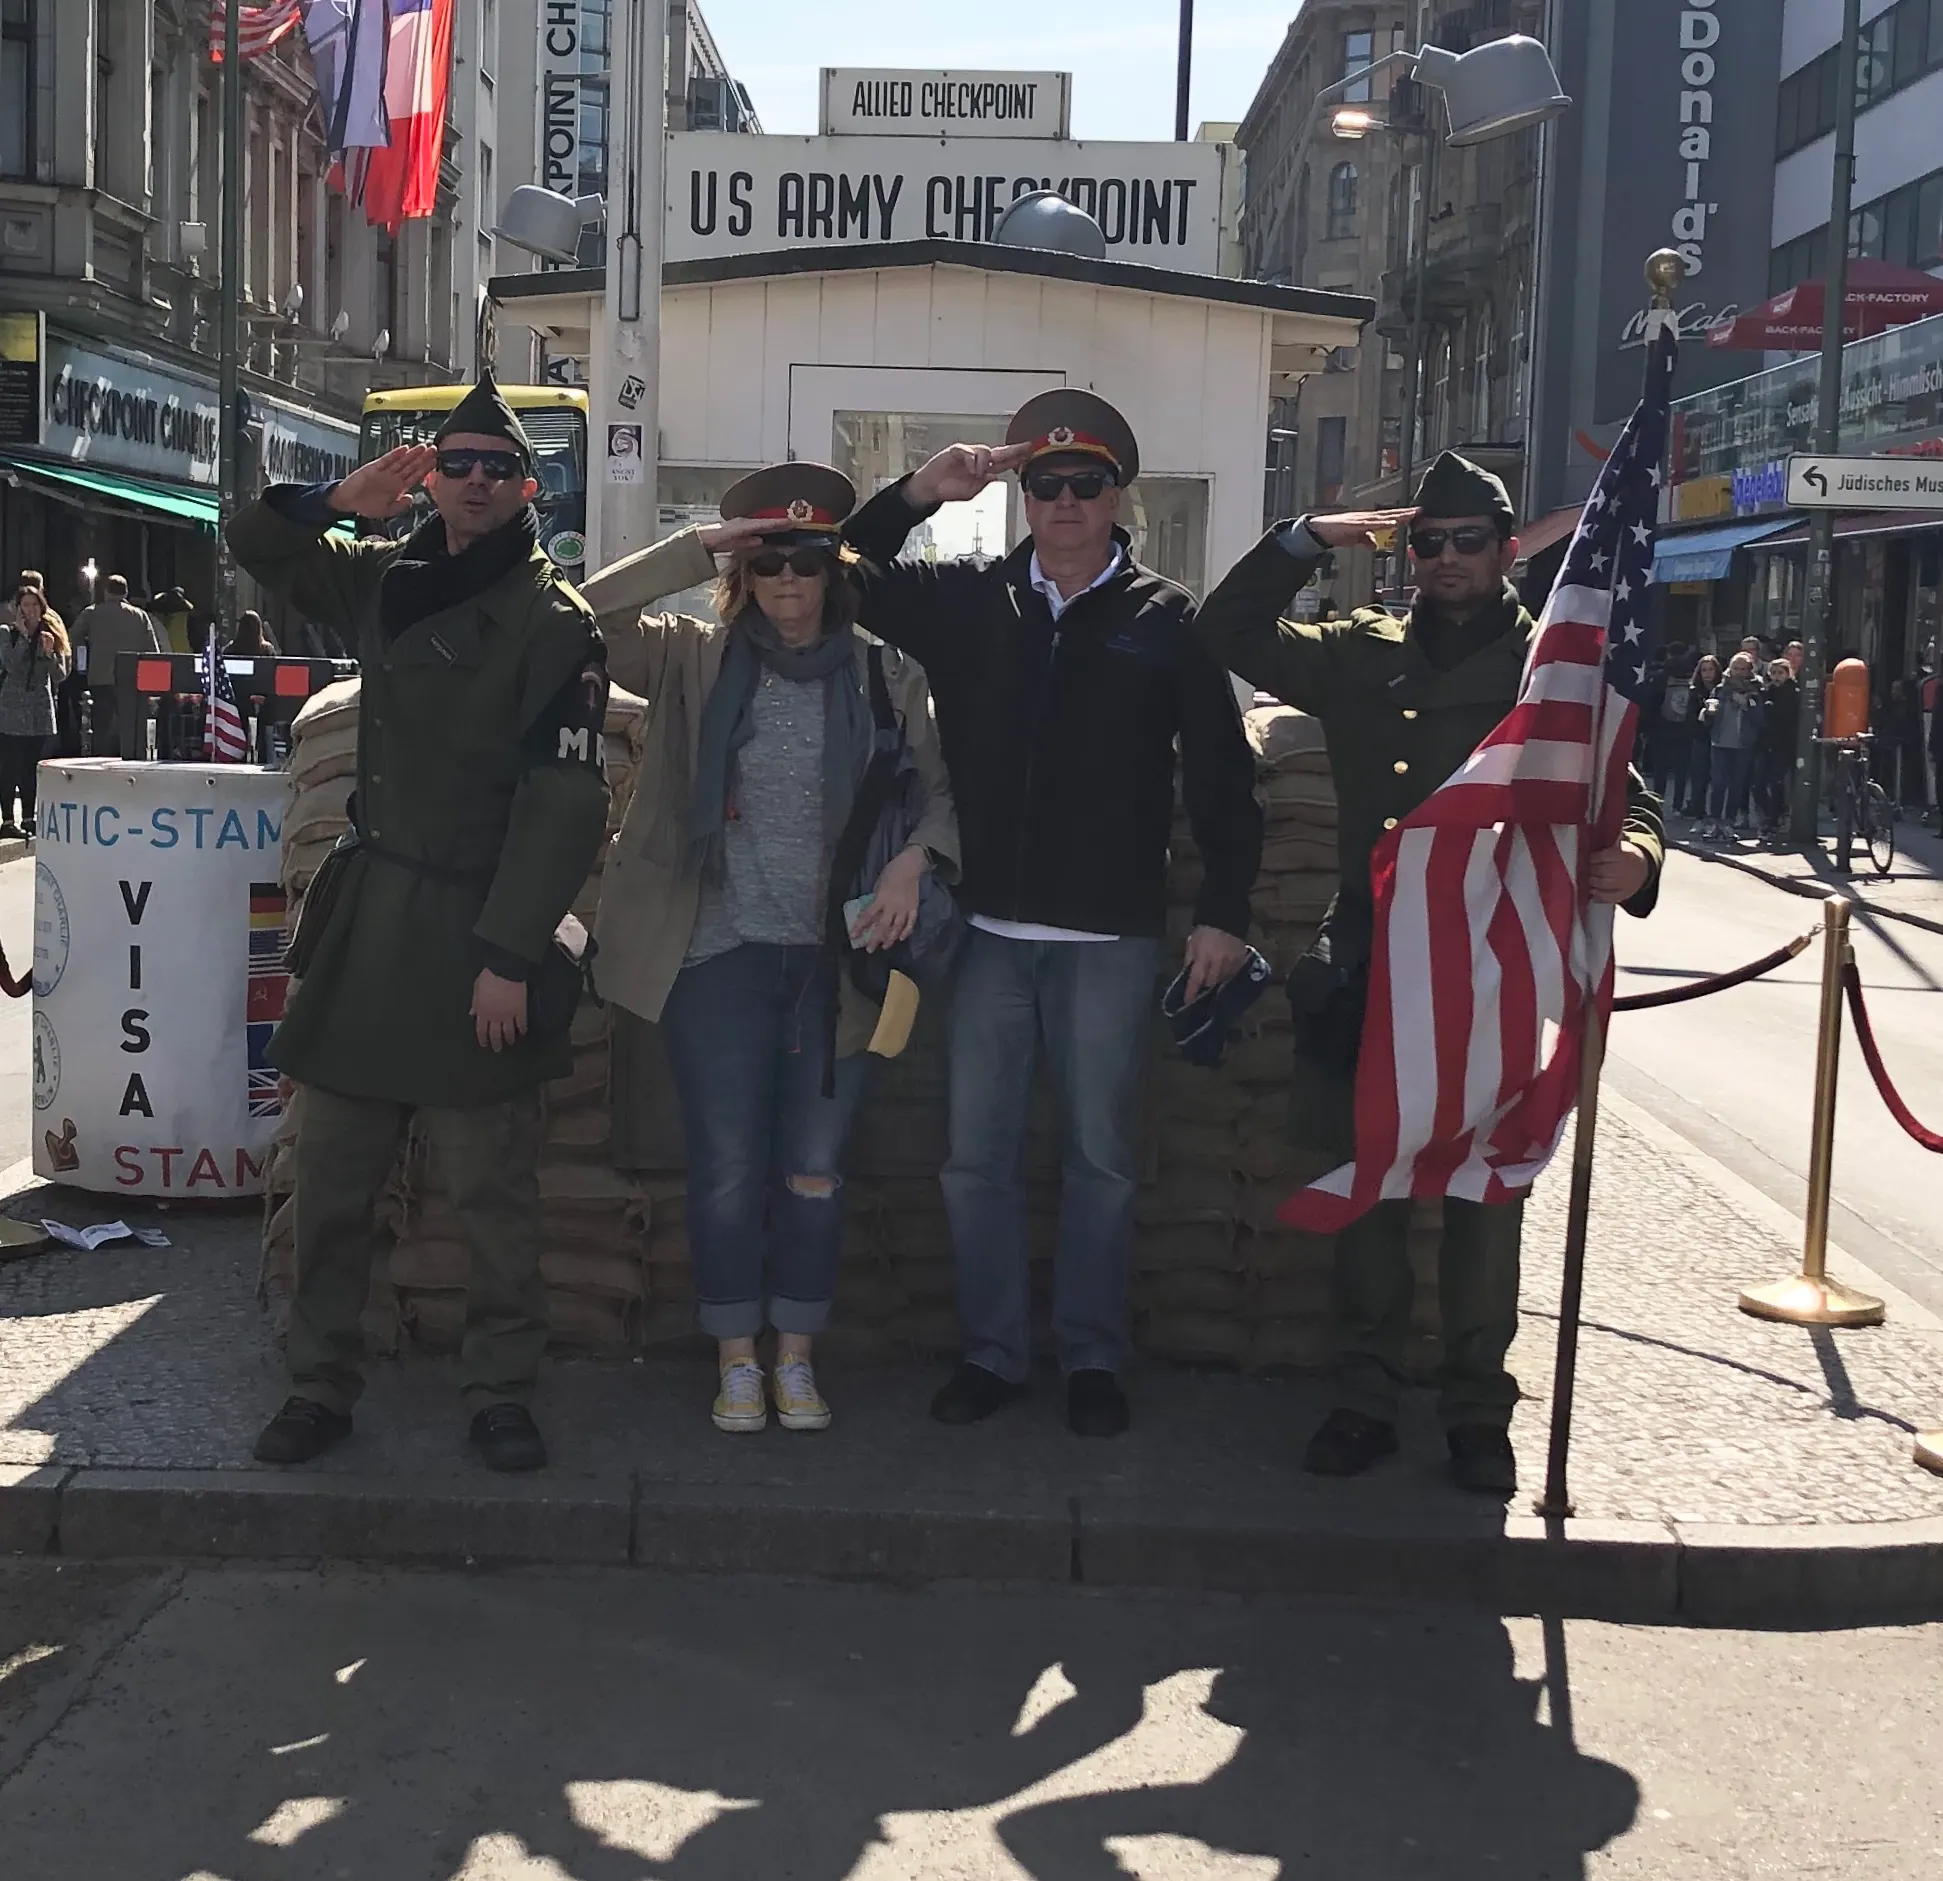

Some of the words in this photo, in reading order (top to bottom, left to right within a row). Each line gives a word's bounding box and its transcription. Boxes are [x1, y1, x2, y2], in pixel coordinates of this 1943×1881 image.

[852, 81, 912, 117] ALLIED
[921, 82, 1037, 120] CHECKPOINT
[1672, 0, 1720, 276] Donald's
[691, 170, 753, 236] US
[778, 172, 904, 240] ARMY
[926, 176, 1197, 245] CHEPOINT
[53, 373, 157, 444] CHECKPOINT
[1837, 474, 1910, 492] Jüdisches
[1915, 476, 1943, 493] Mus
[118, 881, 155, 1118] VISA
